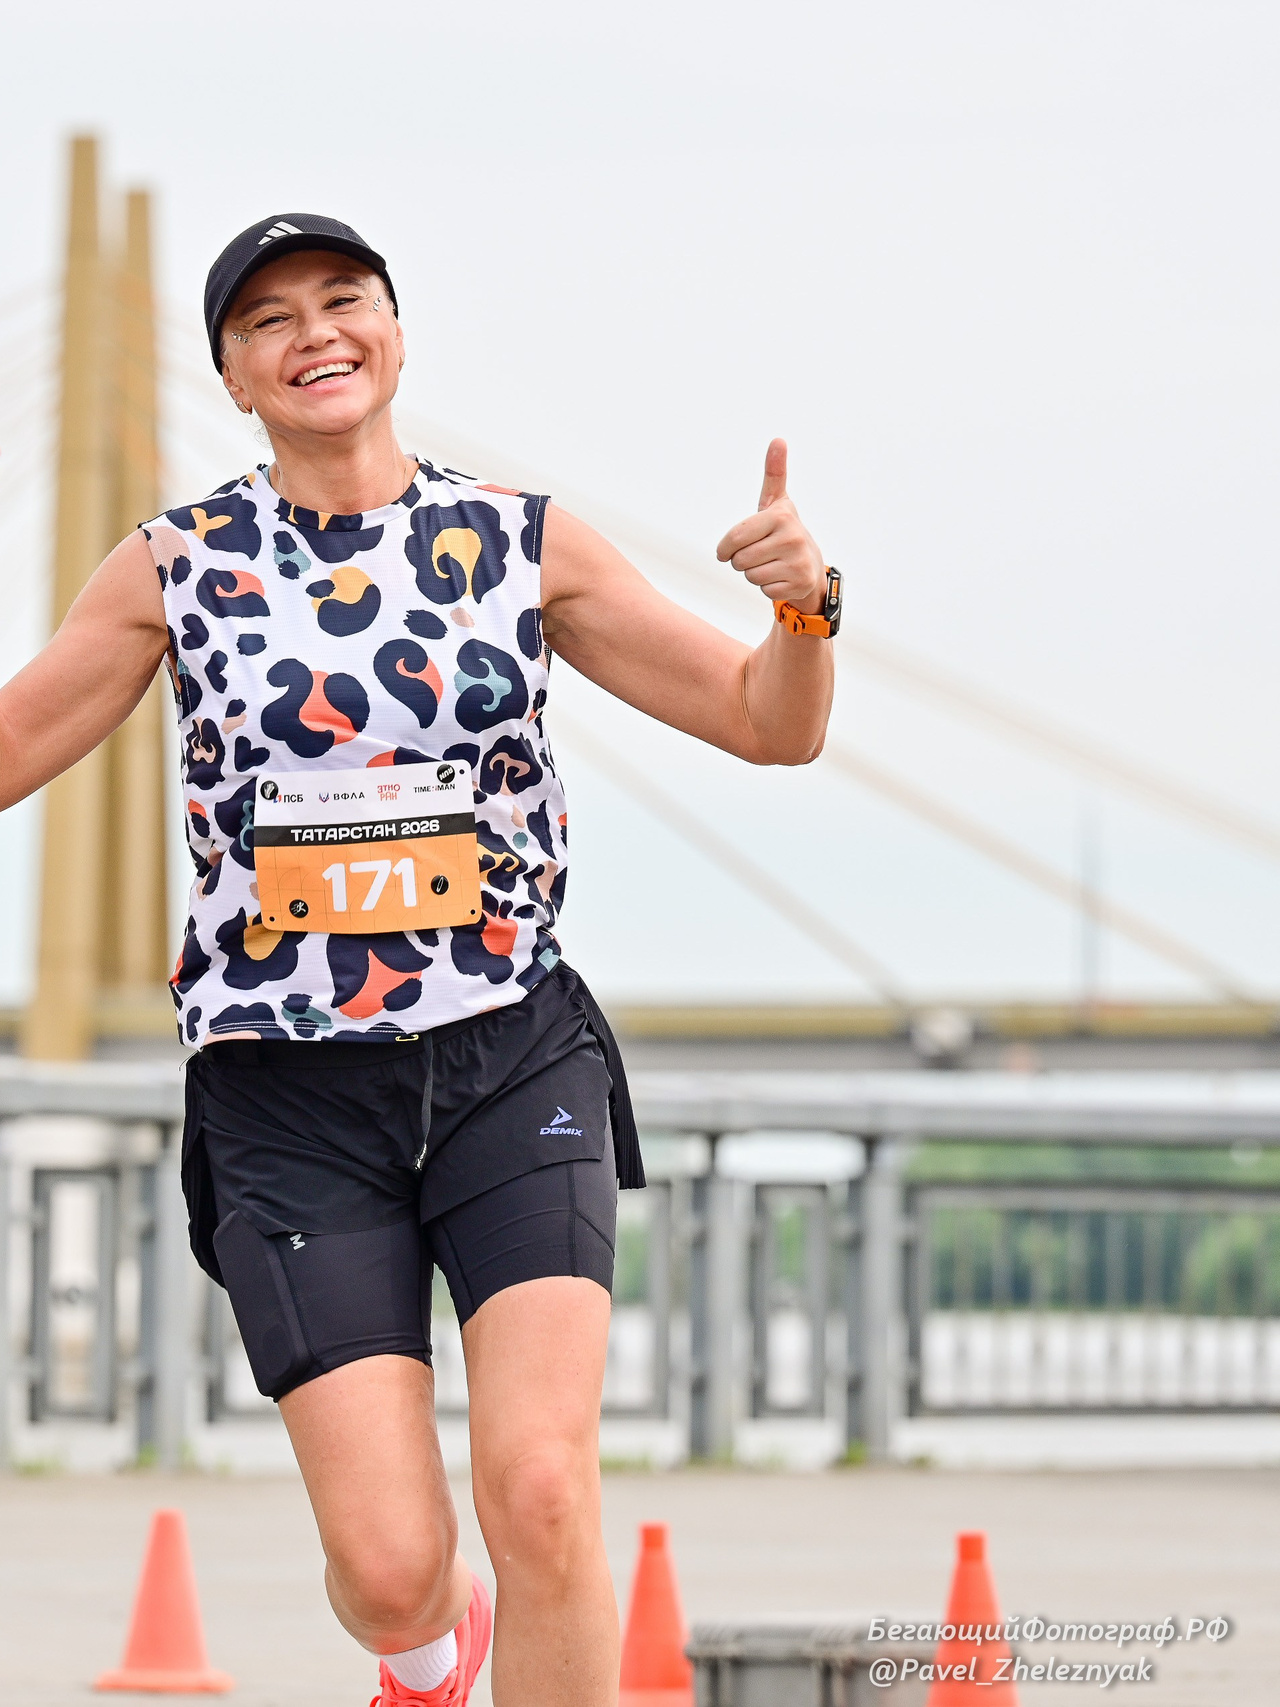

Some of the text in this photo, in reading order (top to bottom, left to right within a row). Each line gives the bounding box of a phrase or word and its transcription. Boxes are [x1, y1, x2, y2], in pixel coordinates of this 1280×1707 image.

[283, 794, 304, 803] ПСБ
[291, 819, 440, 842] ТАТАРСТАН 2026
[322, 857, 417, 912] 171
[540, 1127, 583, 1137] DEMIX
